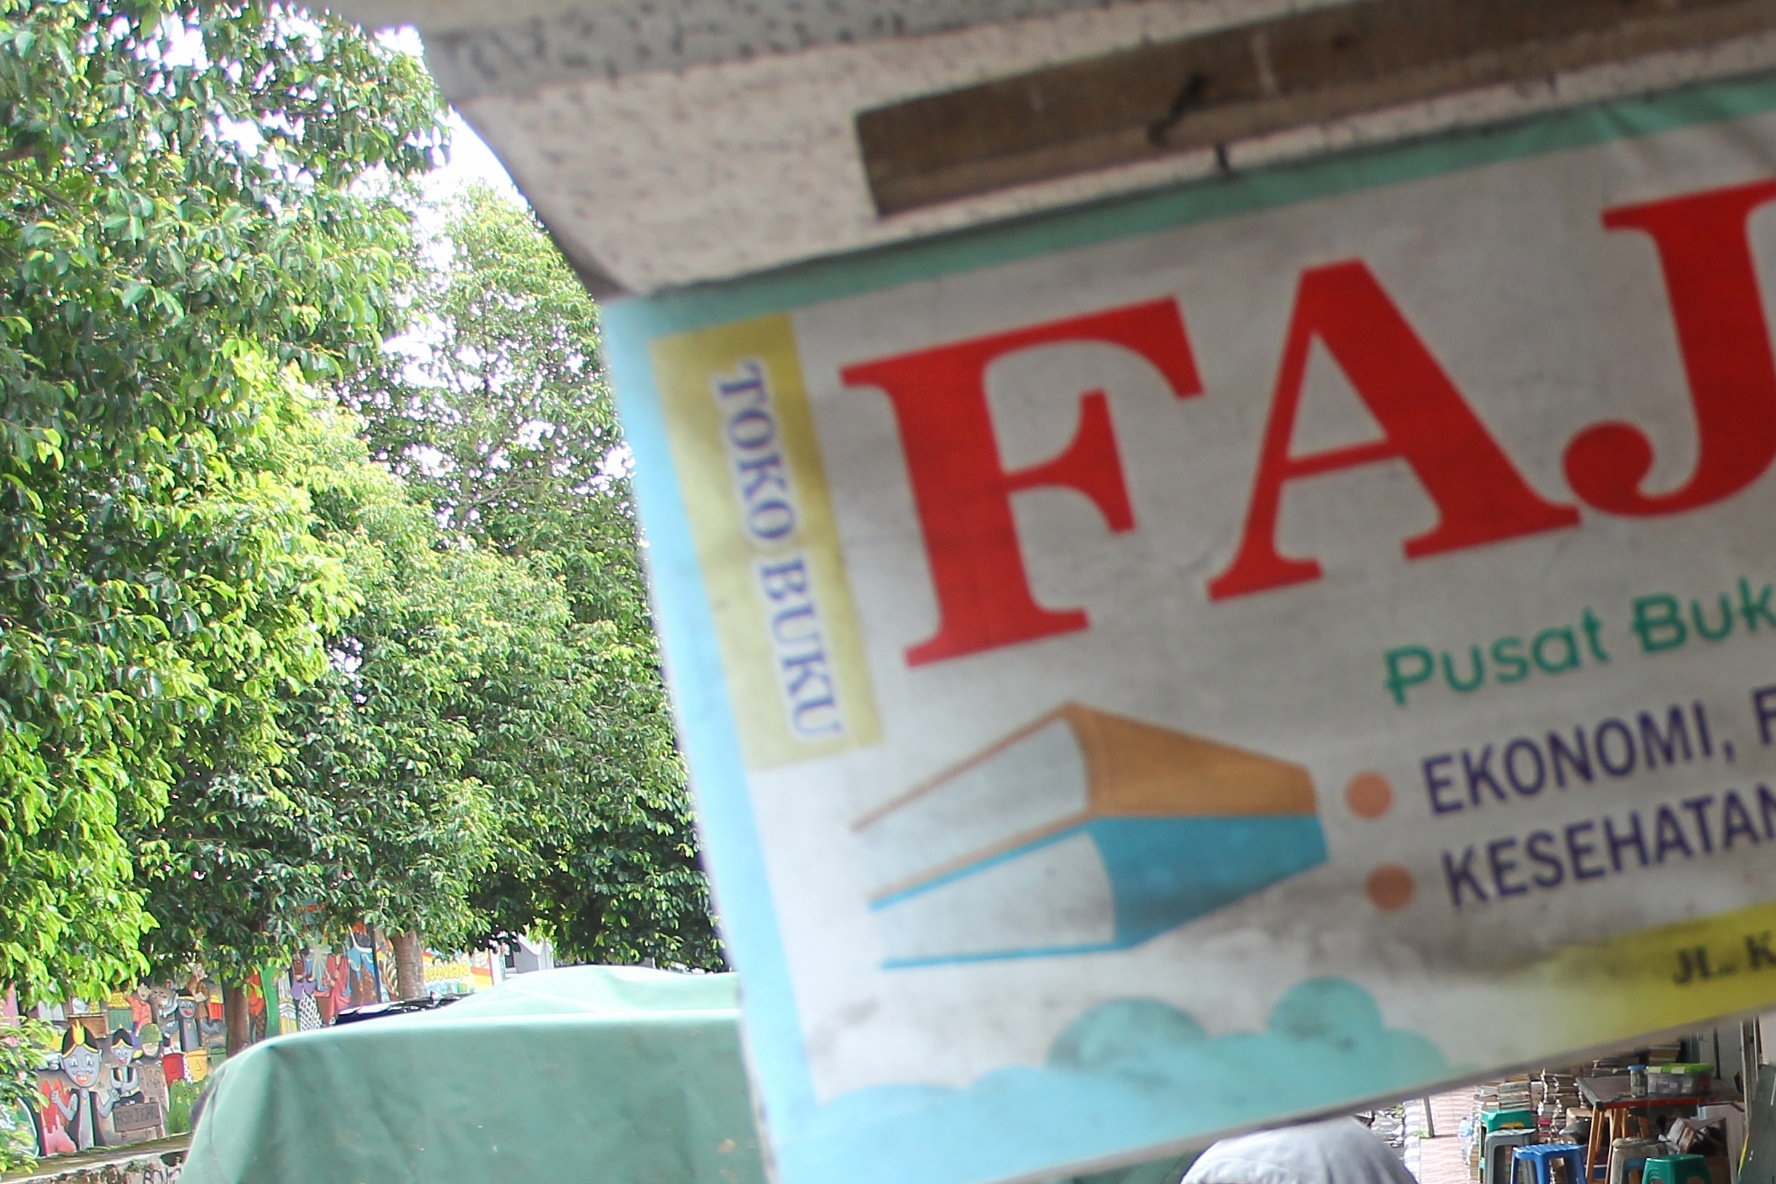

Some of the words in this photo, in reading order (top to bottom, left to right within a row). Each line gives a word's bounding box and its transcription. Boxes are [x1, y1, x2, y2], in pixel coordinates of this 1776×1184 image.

[713, 362, 796, 543] TOKO
[756, 554, 844, 741] BUKU
[1383, 608, 1609, 705] Pusat
[1421, 701, 1736, 816] EKONOMI,
